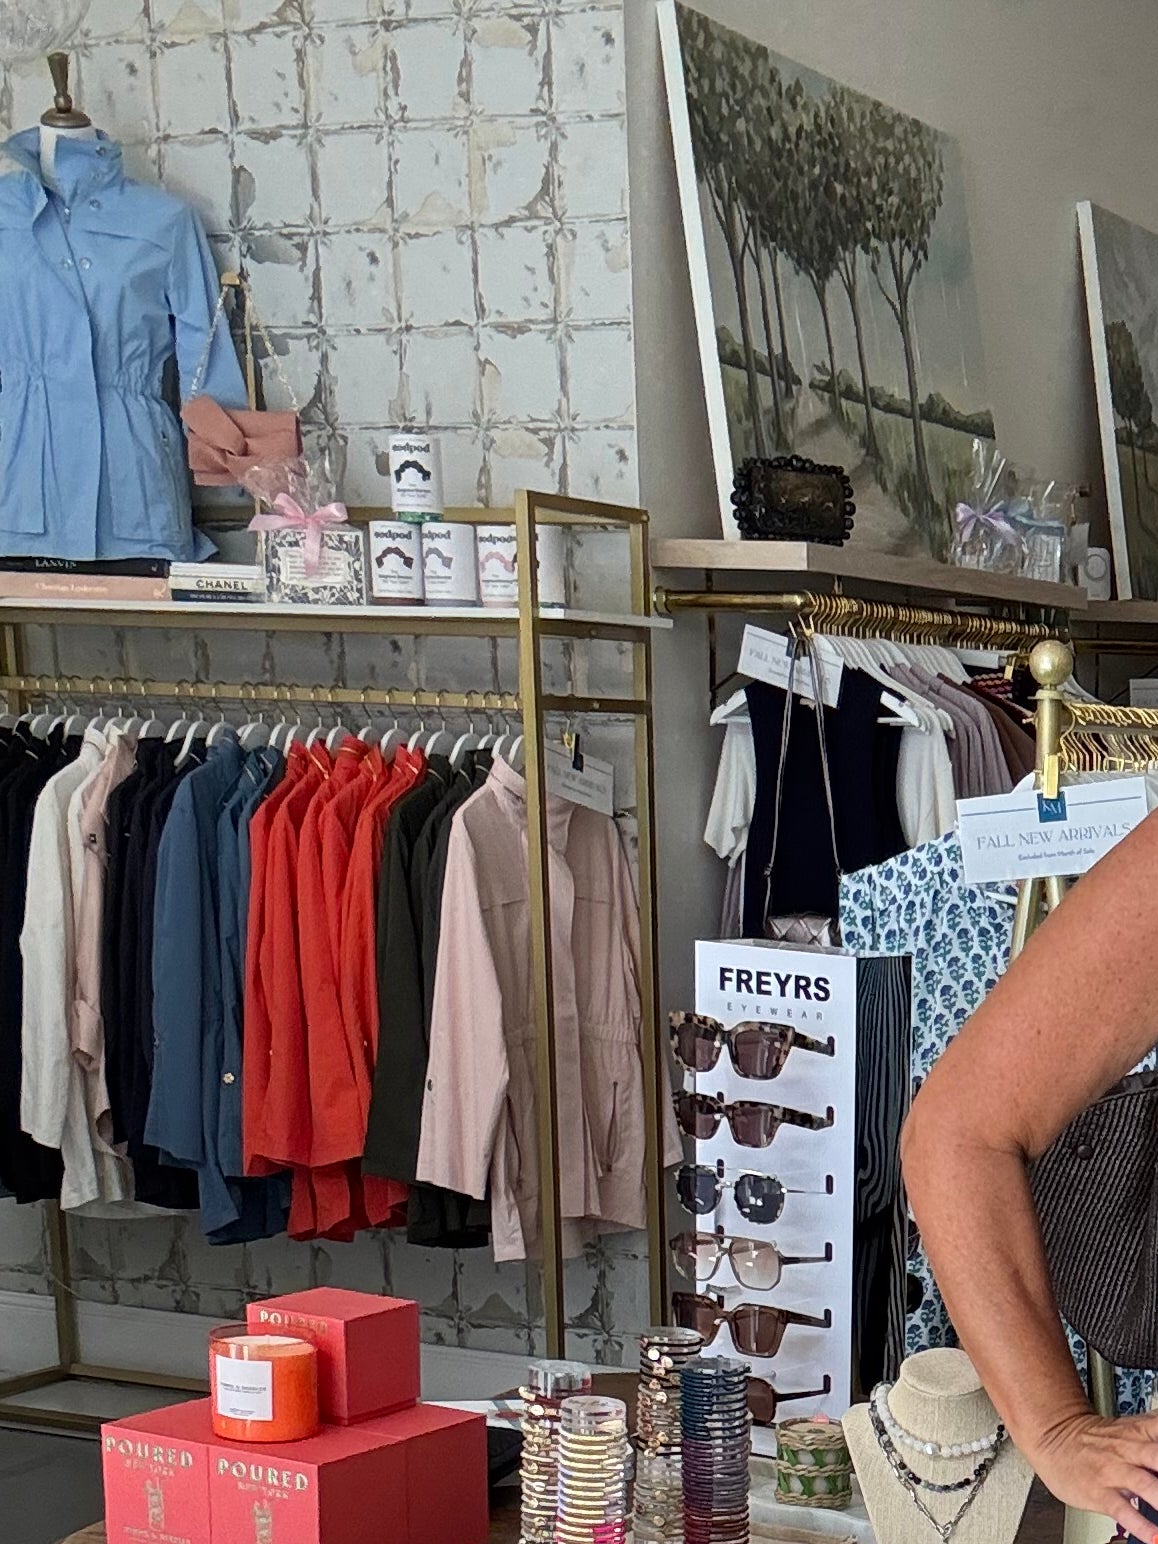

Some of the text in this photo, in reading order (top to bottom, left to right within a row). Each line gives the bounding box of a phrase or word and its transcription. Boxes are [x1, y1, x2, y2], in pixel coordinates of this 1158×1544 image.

[195, 579, 248, 591] CHANEL
[976, 822, 1132, 851] FALL NEW ARRIVALS
[719, 966, 831, 1002] FREYRS
[726, 1002, 823, 1021] EYEWEAR
[104, 1434, 194, 1469] POURED
[216, 1457, 309, 1492] POURED
